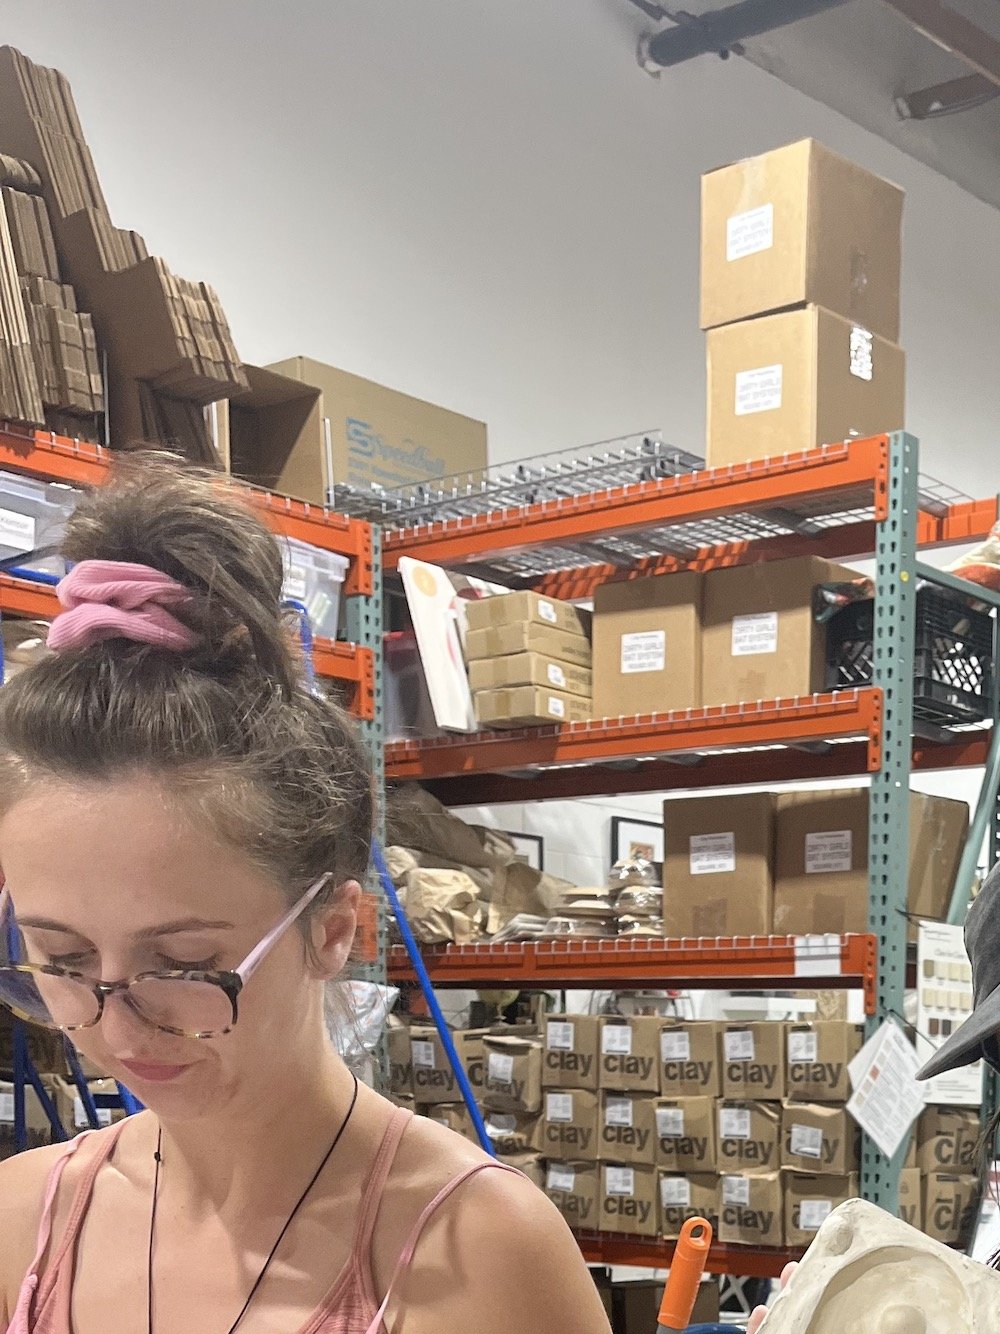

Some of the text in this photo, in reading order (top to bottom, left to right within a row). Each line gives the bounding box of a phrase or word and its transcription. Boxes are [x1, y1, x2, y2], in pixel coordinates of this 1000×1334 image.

[546, 1052, 593, 1077] clay
[604, 1055, 654, 1080] clay
[664, 1060, 713, 1086] clay
[727, 1062, 777, 1089] clay
[790, 1062, 842, 1088] clay
[416, 1069, 454, 1091] clay
[546, 1124, 592, 1150] clay
[603, 1126, 649, 1151] clay
[660, 1136, 708, 1160] clay
[935, 1128, 975, 1166] cla
[721, 1138, 774, 1165] clay
[550, 1192, 593, 1219] clay
[604, 1196, 651, 1224] clay
[723, 1205, 774, 1234] clay
